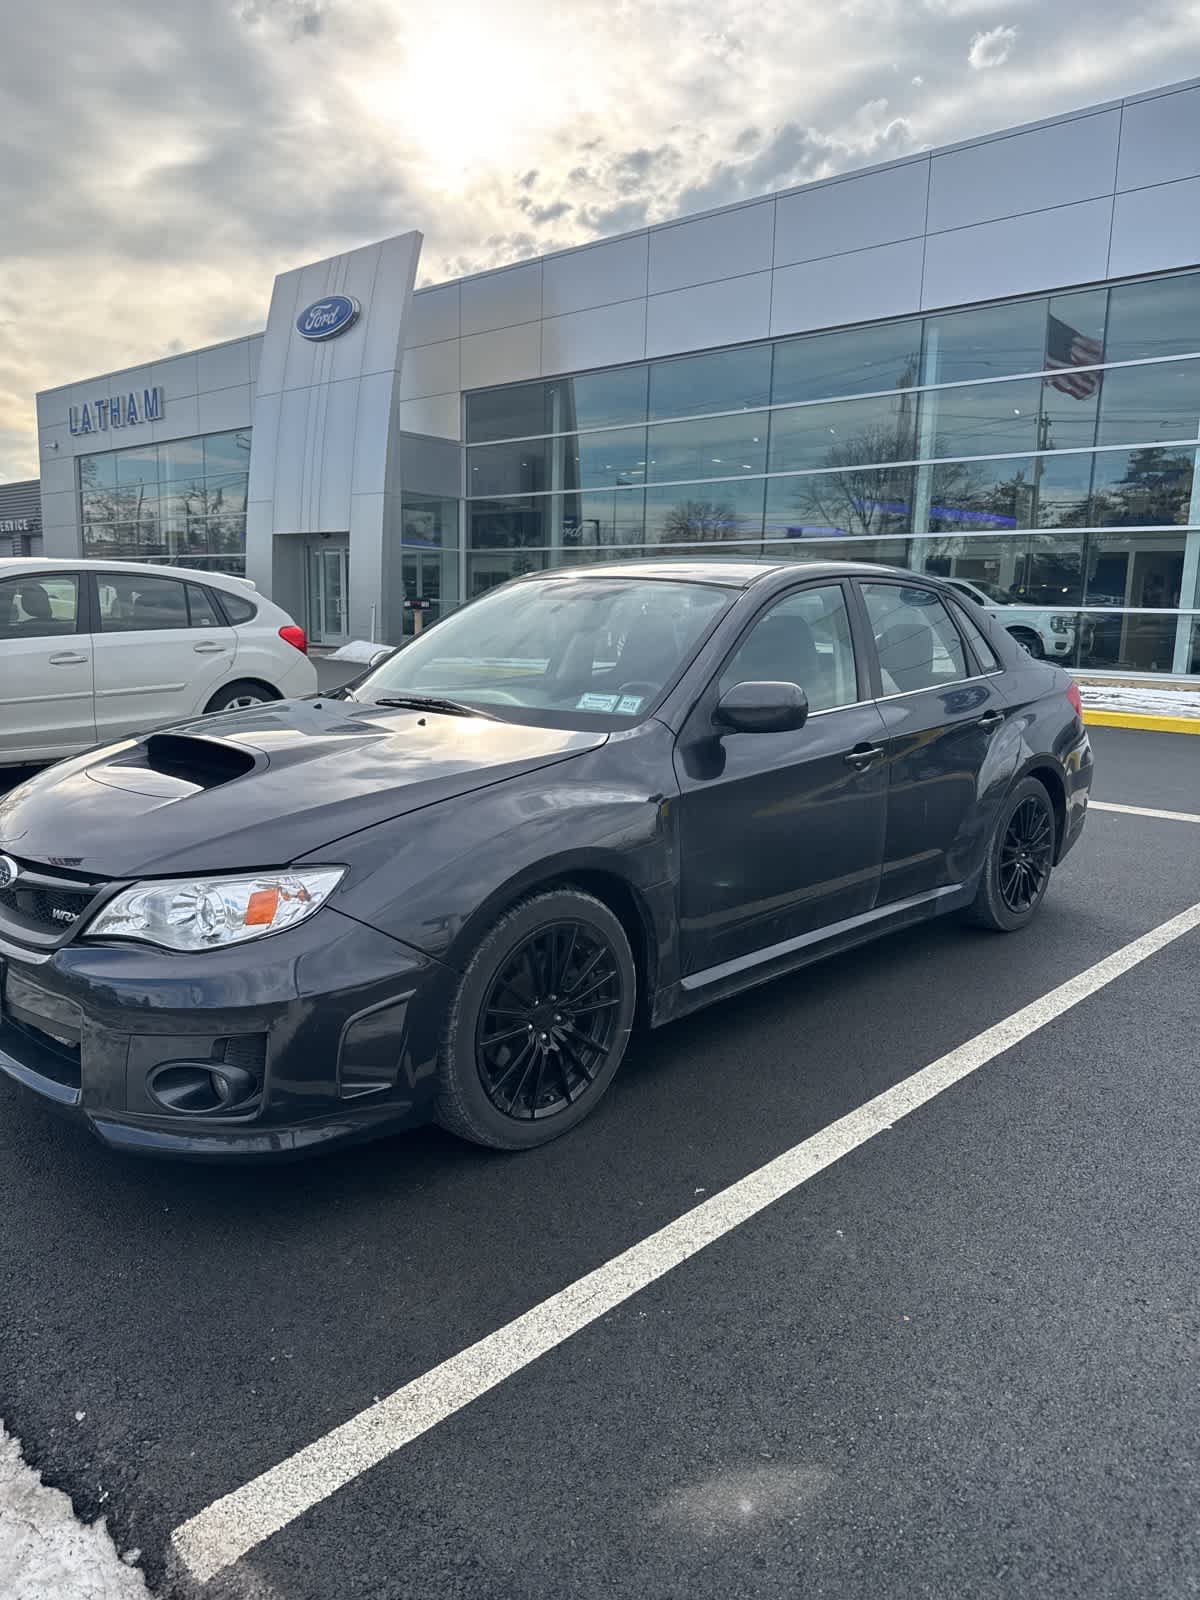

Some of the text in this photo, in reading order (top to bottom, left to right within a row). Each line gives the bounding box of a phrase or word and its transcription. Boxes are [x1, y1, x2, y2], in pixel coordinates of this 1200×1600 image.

[305, 303, 340, 330] Ford
[68, 387, 161, 435] LATHAM
[0, 519, 29, 531] ERVICE
[52, 908, 80, 921] WRX
